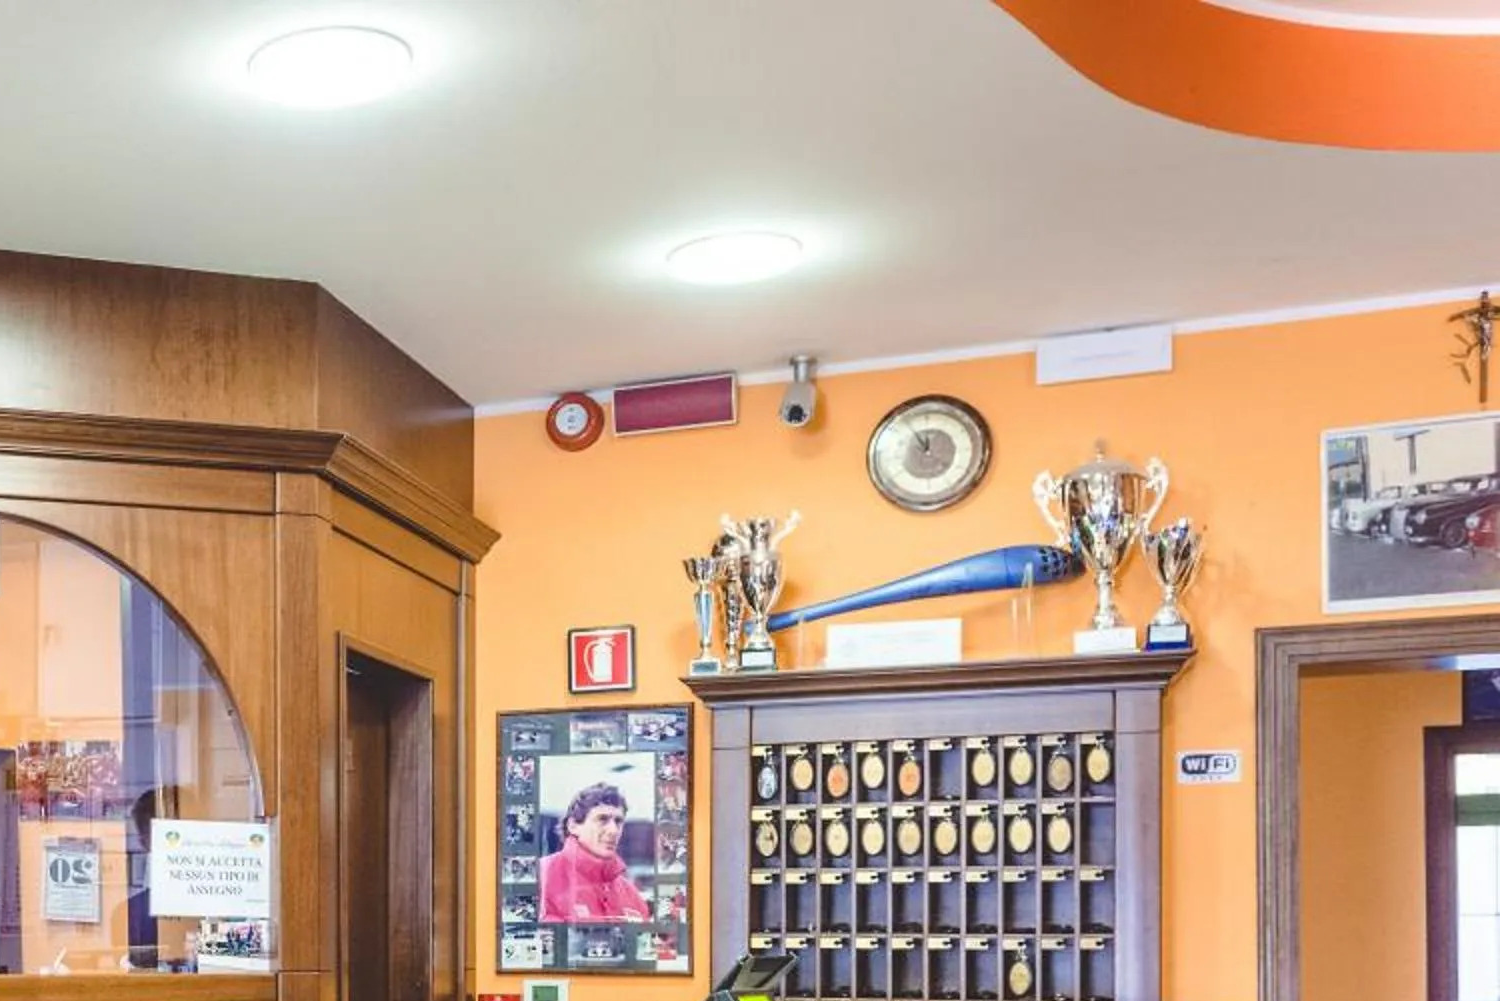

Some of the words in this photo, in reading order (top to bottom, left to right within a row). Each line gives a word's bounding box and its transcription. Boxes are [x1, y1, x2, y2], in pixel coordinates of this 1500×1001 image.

[166, 855, 192, 866] NON
[195, 855, 205, 867] SI
[208, 855, 263, 868] ACCETTA
[169, 870, 215, 881] NESSUN
[219, 871, 245, 881] TIPO
[247, 871, 259, 882] DI
[187, 883, 243, 896] ASSEGNO
